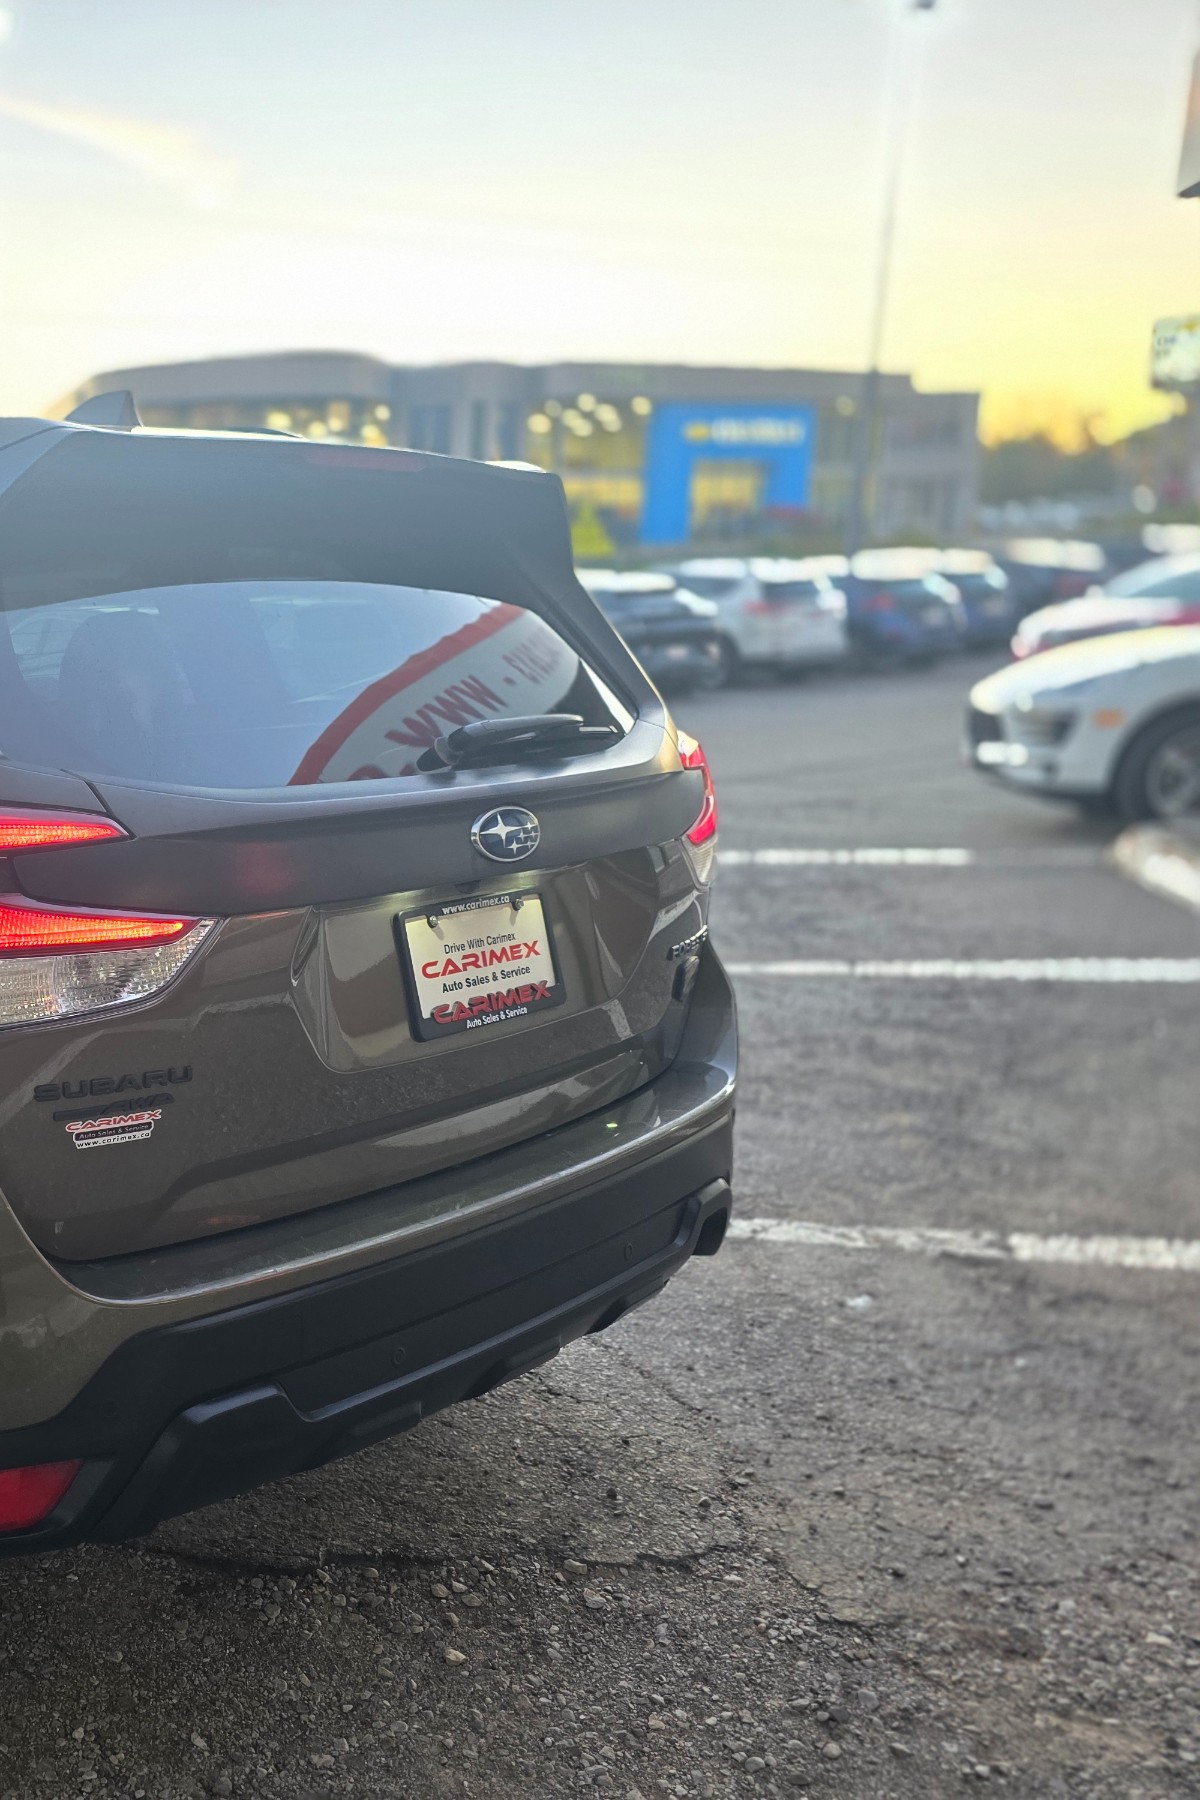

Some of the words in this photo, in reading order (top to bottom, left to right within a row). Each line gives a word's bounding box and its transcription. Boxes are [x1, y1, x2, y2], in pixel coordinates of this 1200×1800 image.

[442, 895, 510, 915] www.carimex.ca
[444, 943, 466, 954] Drive
[467, 938, 485, 950] With
[486, 932, 516, 945] Carimex
[421, 940, 541, 979] CARIMEX
[442, 979, 464, 993] Auto
[465, 974, 490, 988] Sales
[492, 972, 499, 982] &
[500, 965, 531, 980] Service
[432, 979, 551, 1025] CARIMEX
[466, 1018, 482, 1029] Auto
[483, 1013, 499, 1024] Sales
[500, 1011, 506, 1021] &
[506, 1005, 528, 1017] Service
[33, 1065, 193, 1102] SUBARU
[66, 1111, 161, 1131] CARIMEX
[79, 1131, 96, 1140] Auto
[97, 1128, 116, 1137] Sales
[124, 1123, 149, 1133] Service
[77, 1132, 150, 1149] www.carimex.ca
